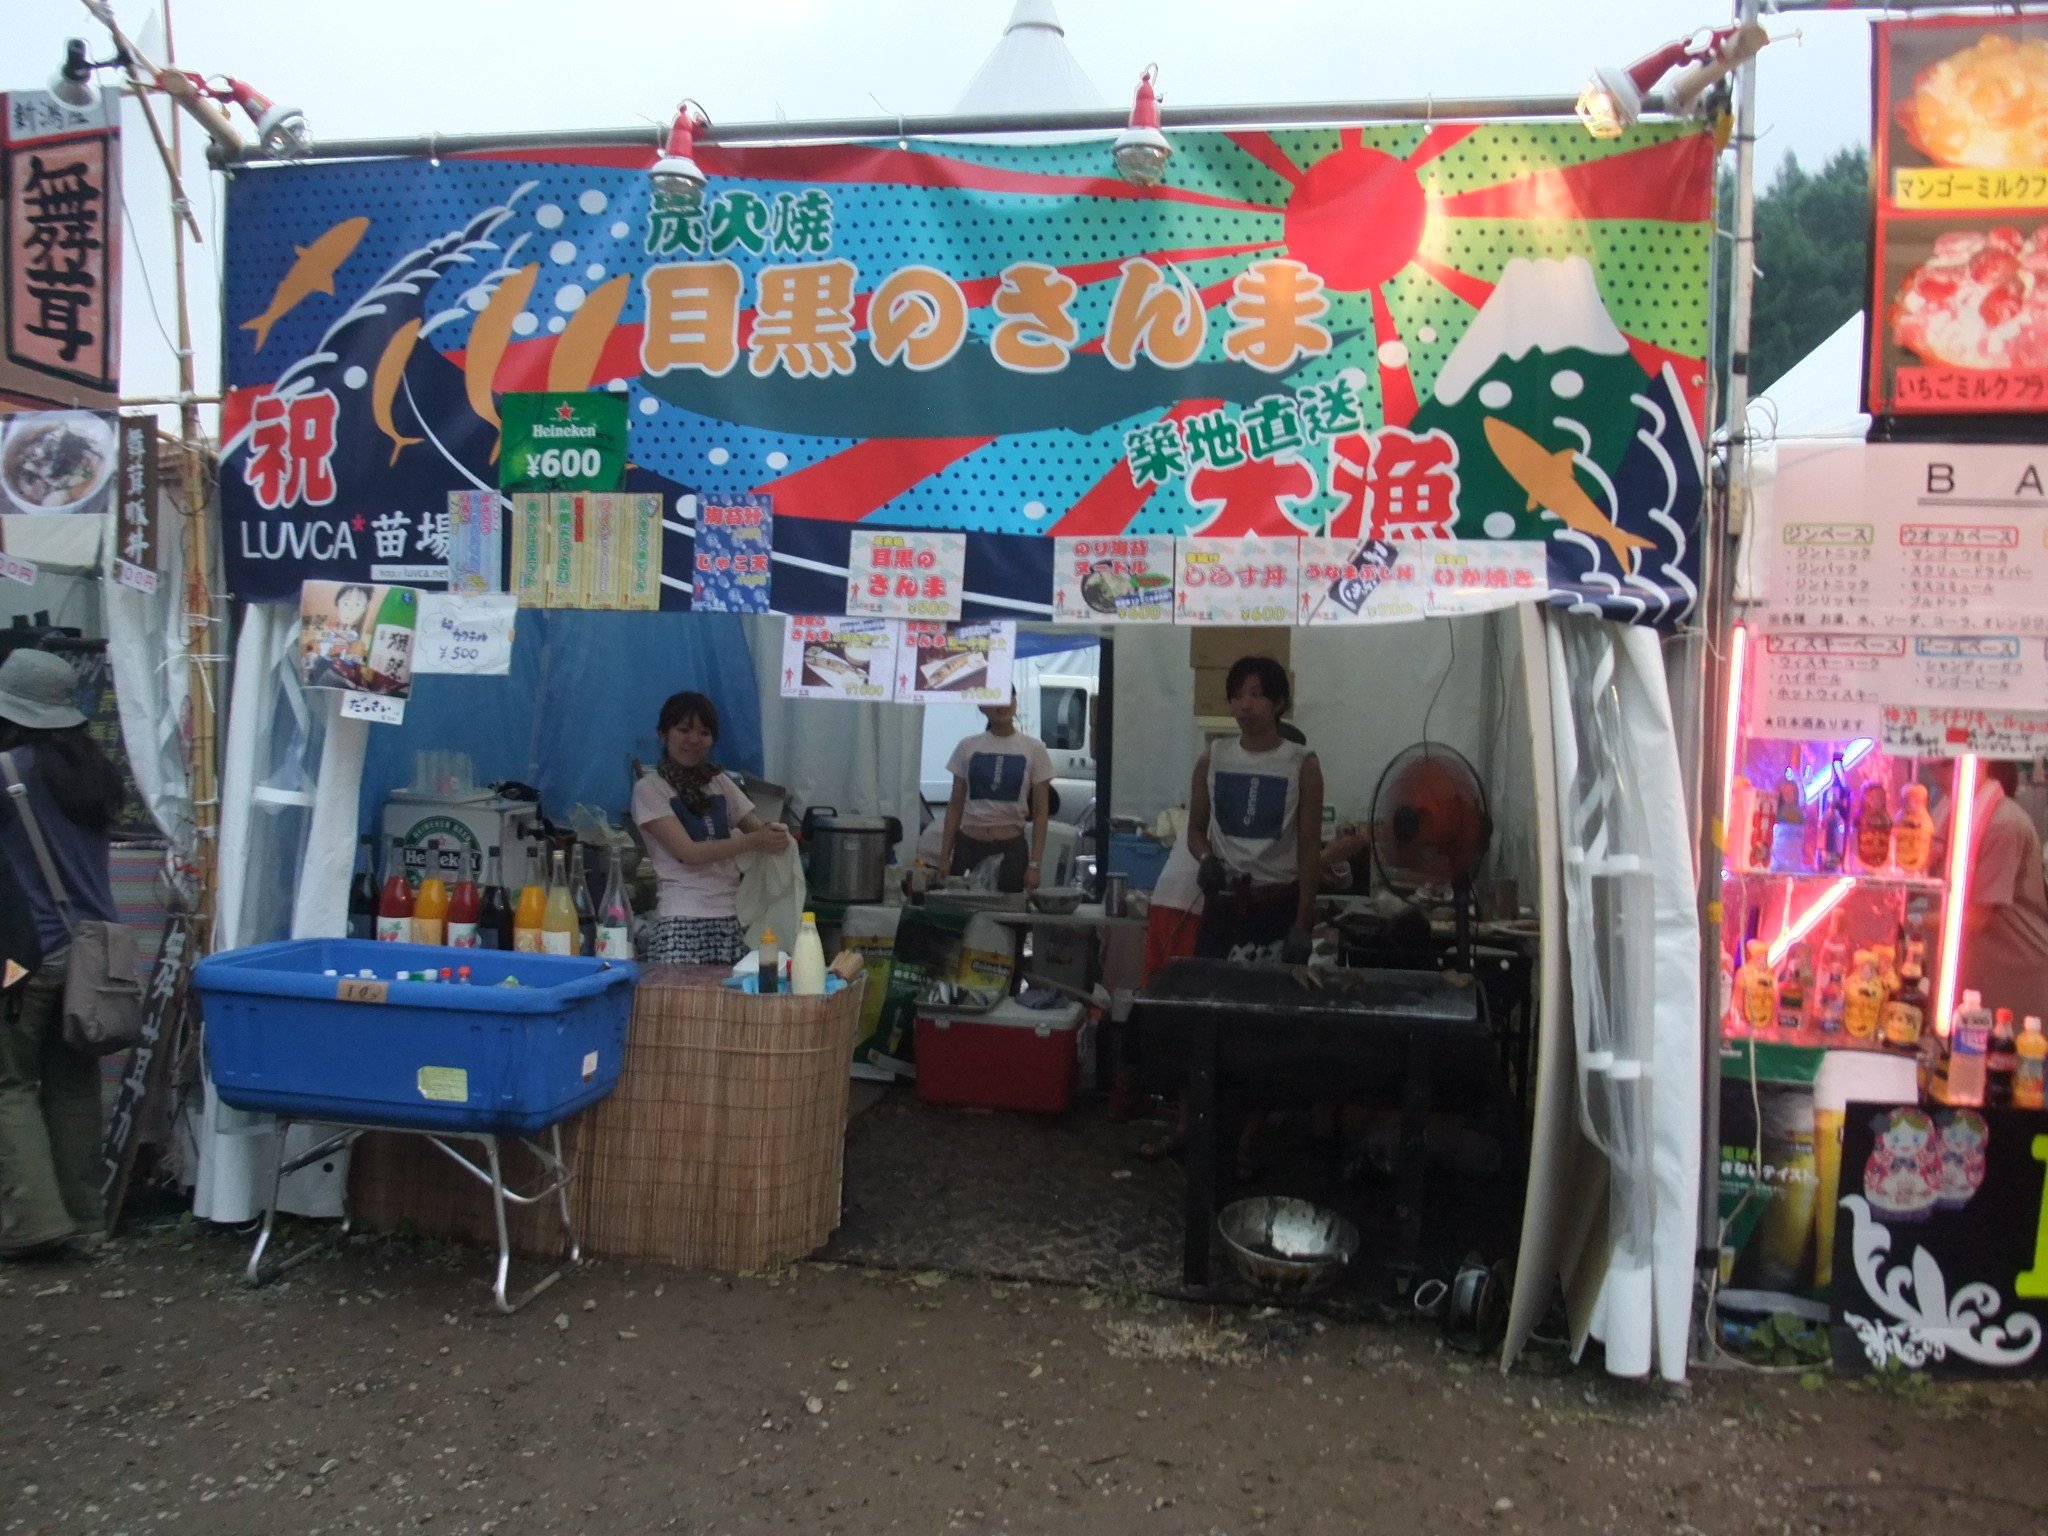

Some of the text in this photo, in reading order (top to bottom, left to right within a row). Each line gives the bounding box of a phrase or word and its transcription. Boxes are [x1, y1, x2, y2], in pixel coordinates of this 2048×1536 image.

[640, 257, 1333, 378] 目黒のさんま
[532, 424, 597, 438] Heineken
[1124, 377, 1364, 489] 築地直送
[245, 388, 339, 508] 祝
[526, 448, 601, 478] ¥600
[1185, 425, 1461, 540] 大漁
[1927, 463, 2045, 497] B A
[371, 510, 451, 560] 苗場
[695, 553, 768, 573] じゃこ天
[871, 546, 936, 570] 目黒の
[867, 571, 947, 599] さんま
[1182, 564, 1288, 588] しらす丼
